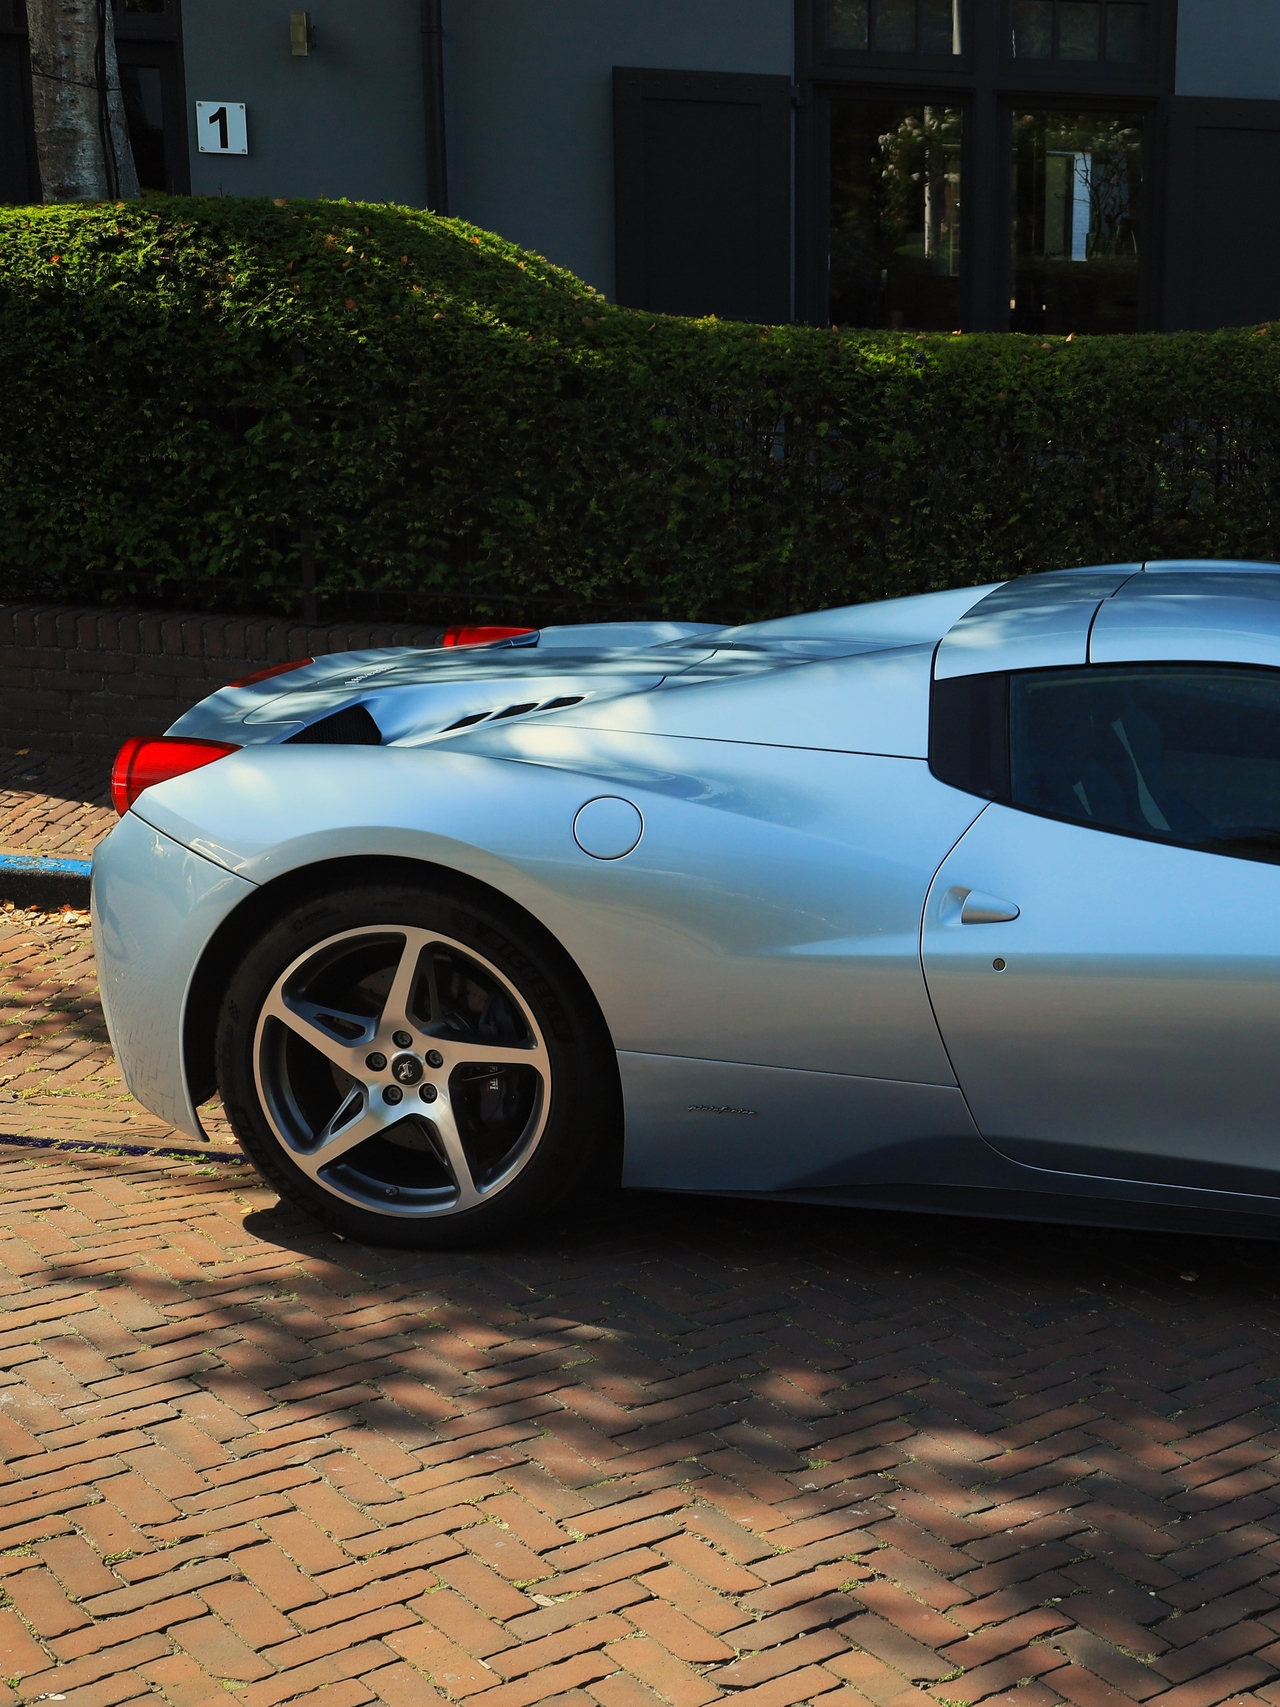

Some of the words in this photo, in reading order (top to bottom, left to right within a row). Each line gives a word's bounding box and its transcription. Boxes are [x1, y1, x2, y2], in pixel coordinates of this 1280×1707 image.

[208, 106, 229, 149] 1
[485, 929, 571, 1036] MICHELIN
[230, 1107, 315, 1213] MICHELIN
